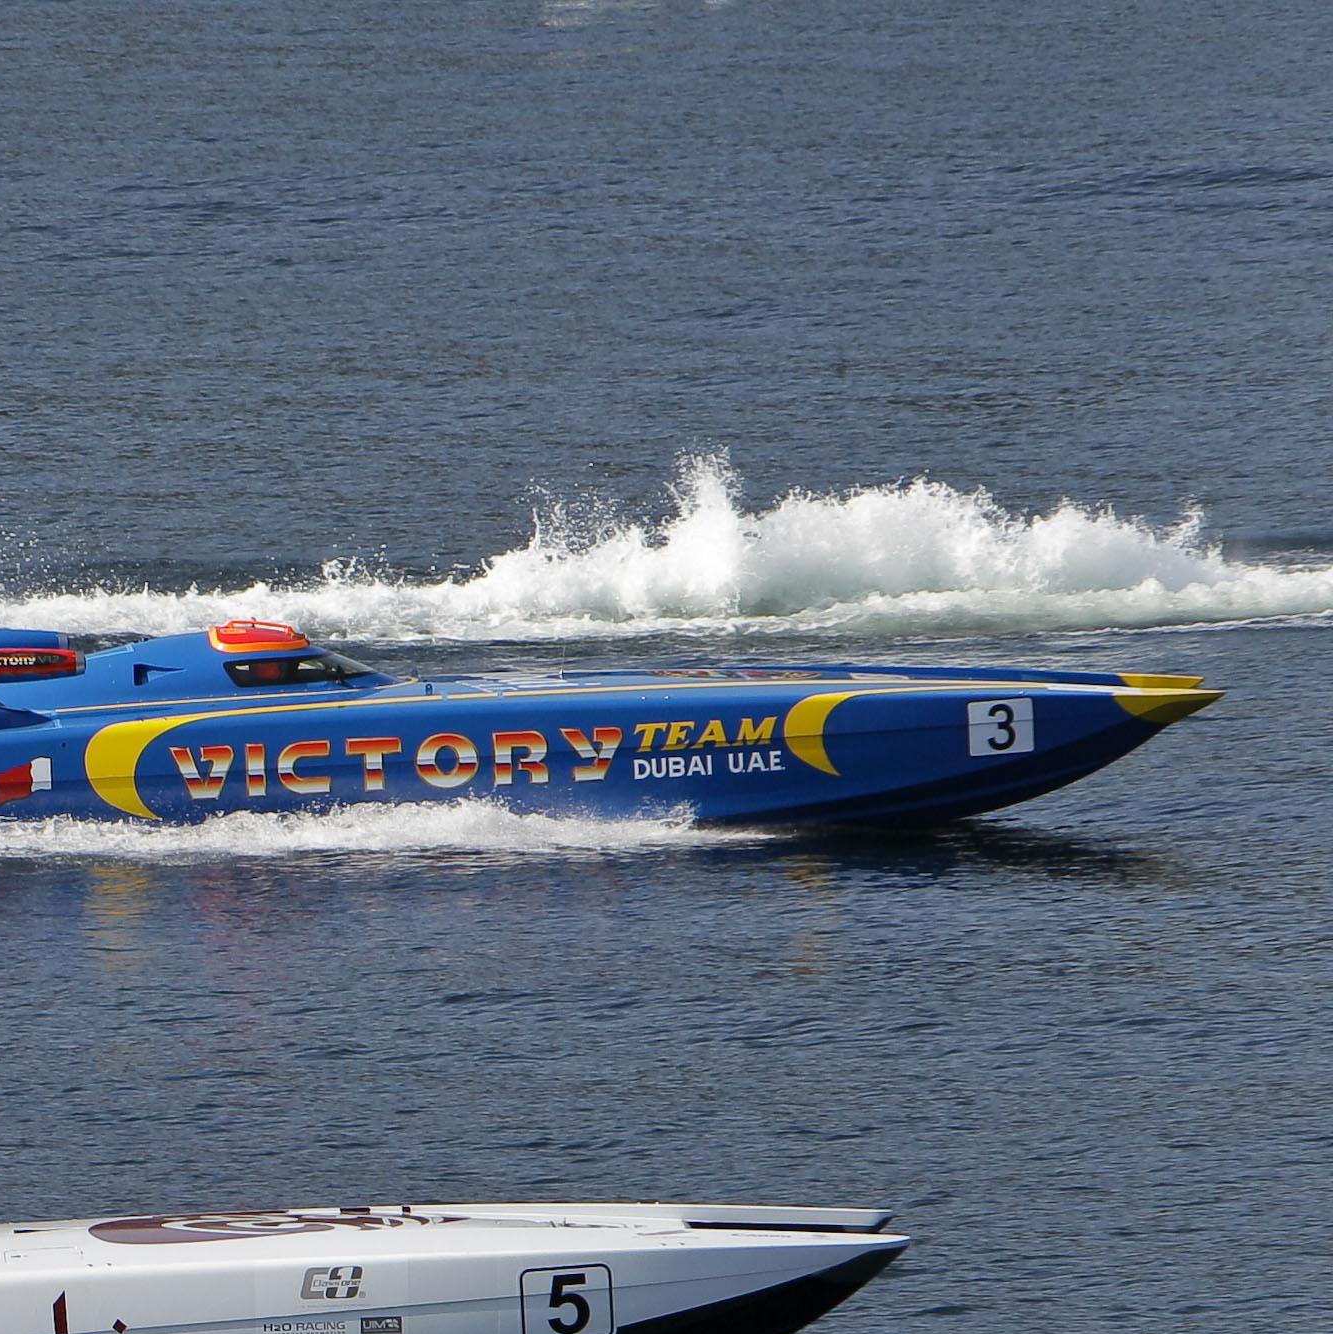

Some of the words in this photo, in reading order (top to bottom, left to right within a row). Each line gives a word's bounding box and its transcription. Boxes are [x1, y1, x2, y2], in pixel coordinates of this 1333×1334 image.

[633, 716, 778, 751] TEAM
[988, 703, 1016, 750] 3
[168, 727, 622, 799] VICTORY
[633, 755, 714, 780] DUBAI
[547, 1273, 591, 1334] 5
[263, 1322, 292, 1332] H2O
[296, 1321, 346, 1331] RACING
